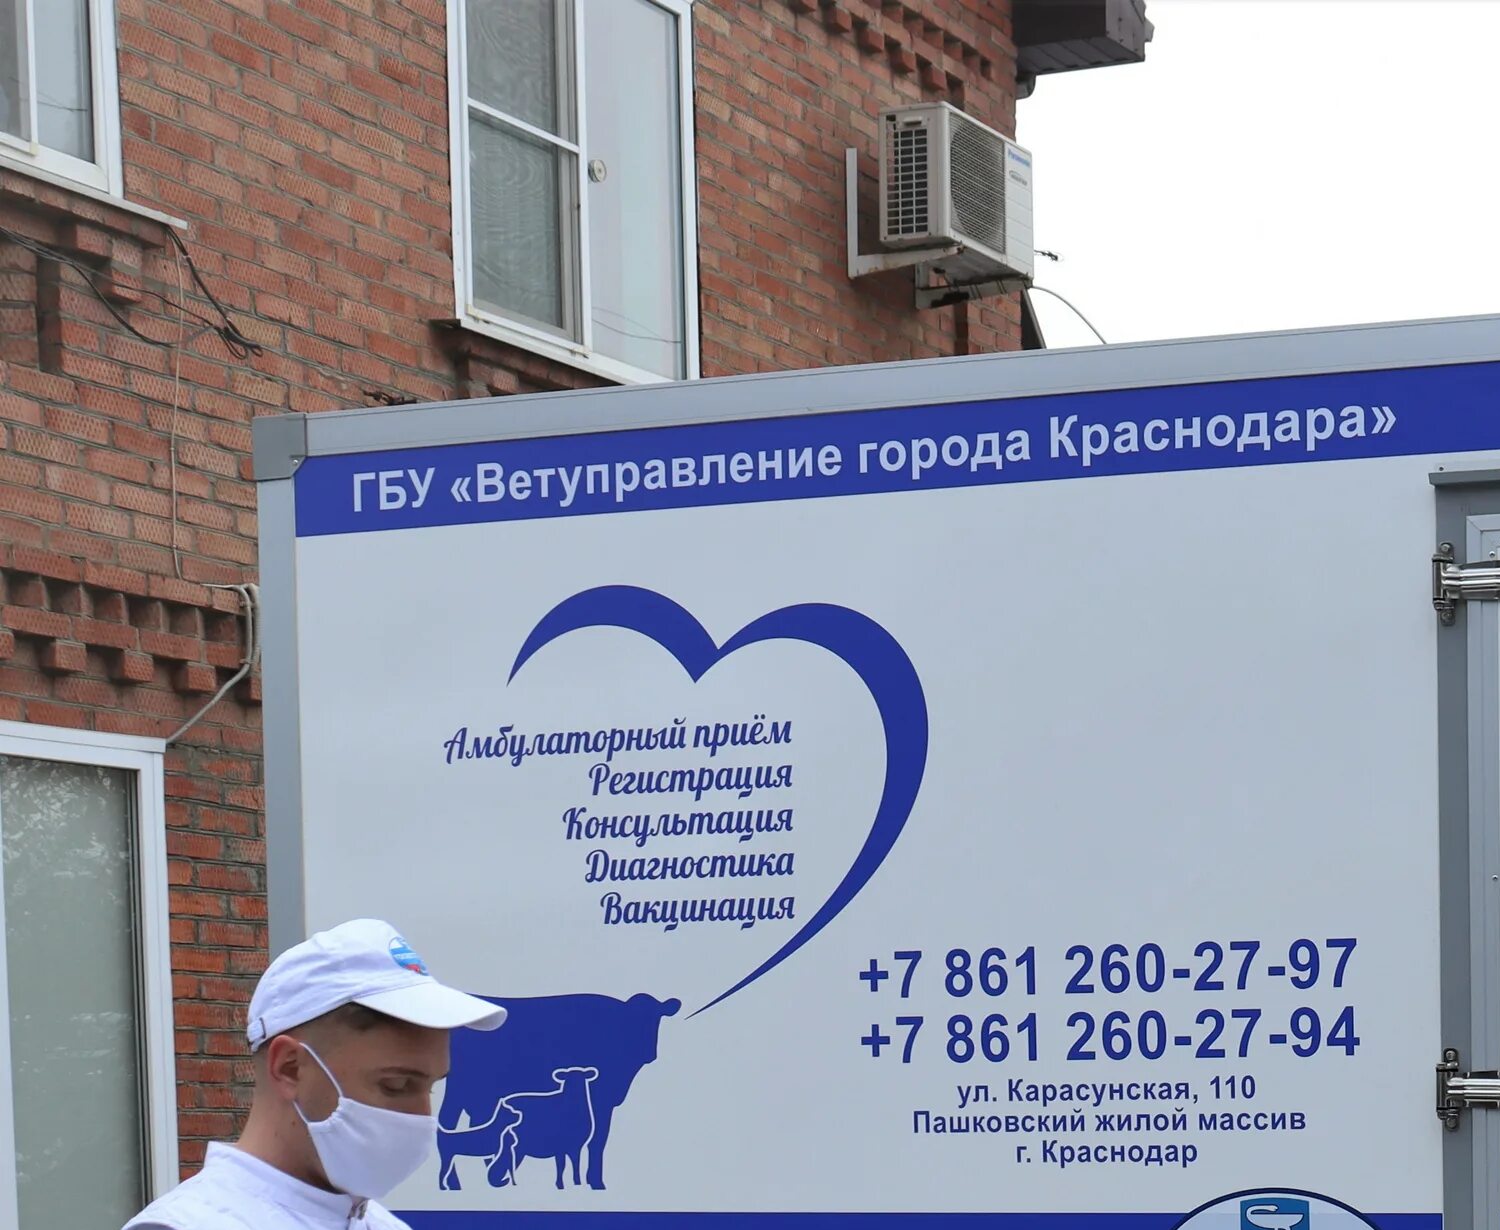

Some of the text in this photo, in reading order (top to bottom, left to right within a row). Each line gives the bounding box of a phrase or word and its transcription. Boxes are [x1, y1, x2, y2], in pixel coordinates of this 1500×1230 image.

[353, 404, 1398, 513] ГБУ «Ветуправление города Краснодара»
[443, 713, 792, 767] Амбулаторный приём
[588, 762, 793, 802] Регистрация
[562, 806, 794, 848] Консультация
[584, 849, 795, 884] Диагностика
[599, 891, 795, 933] Вакцинация
[859, 937, 1357, 999] +7 861 260-27-97
[860, 1005, 1361, 1064] +7 861 260-27-94
[957, 1074, 1256, 1109] ул. Карасунская, 110
[912, 1107, 1306, 1134] Пашковский жилой массив
[1016, 1139, 1198, 1169] г. Краснодар
